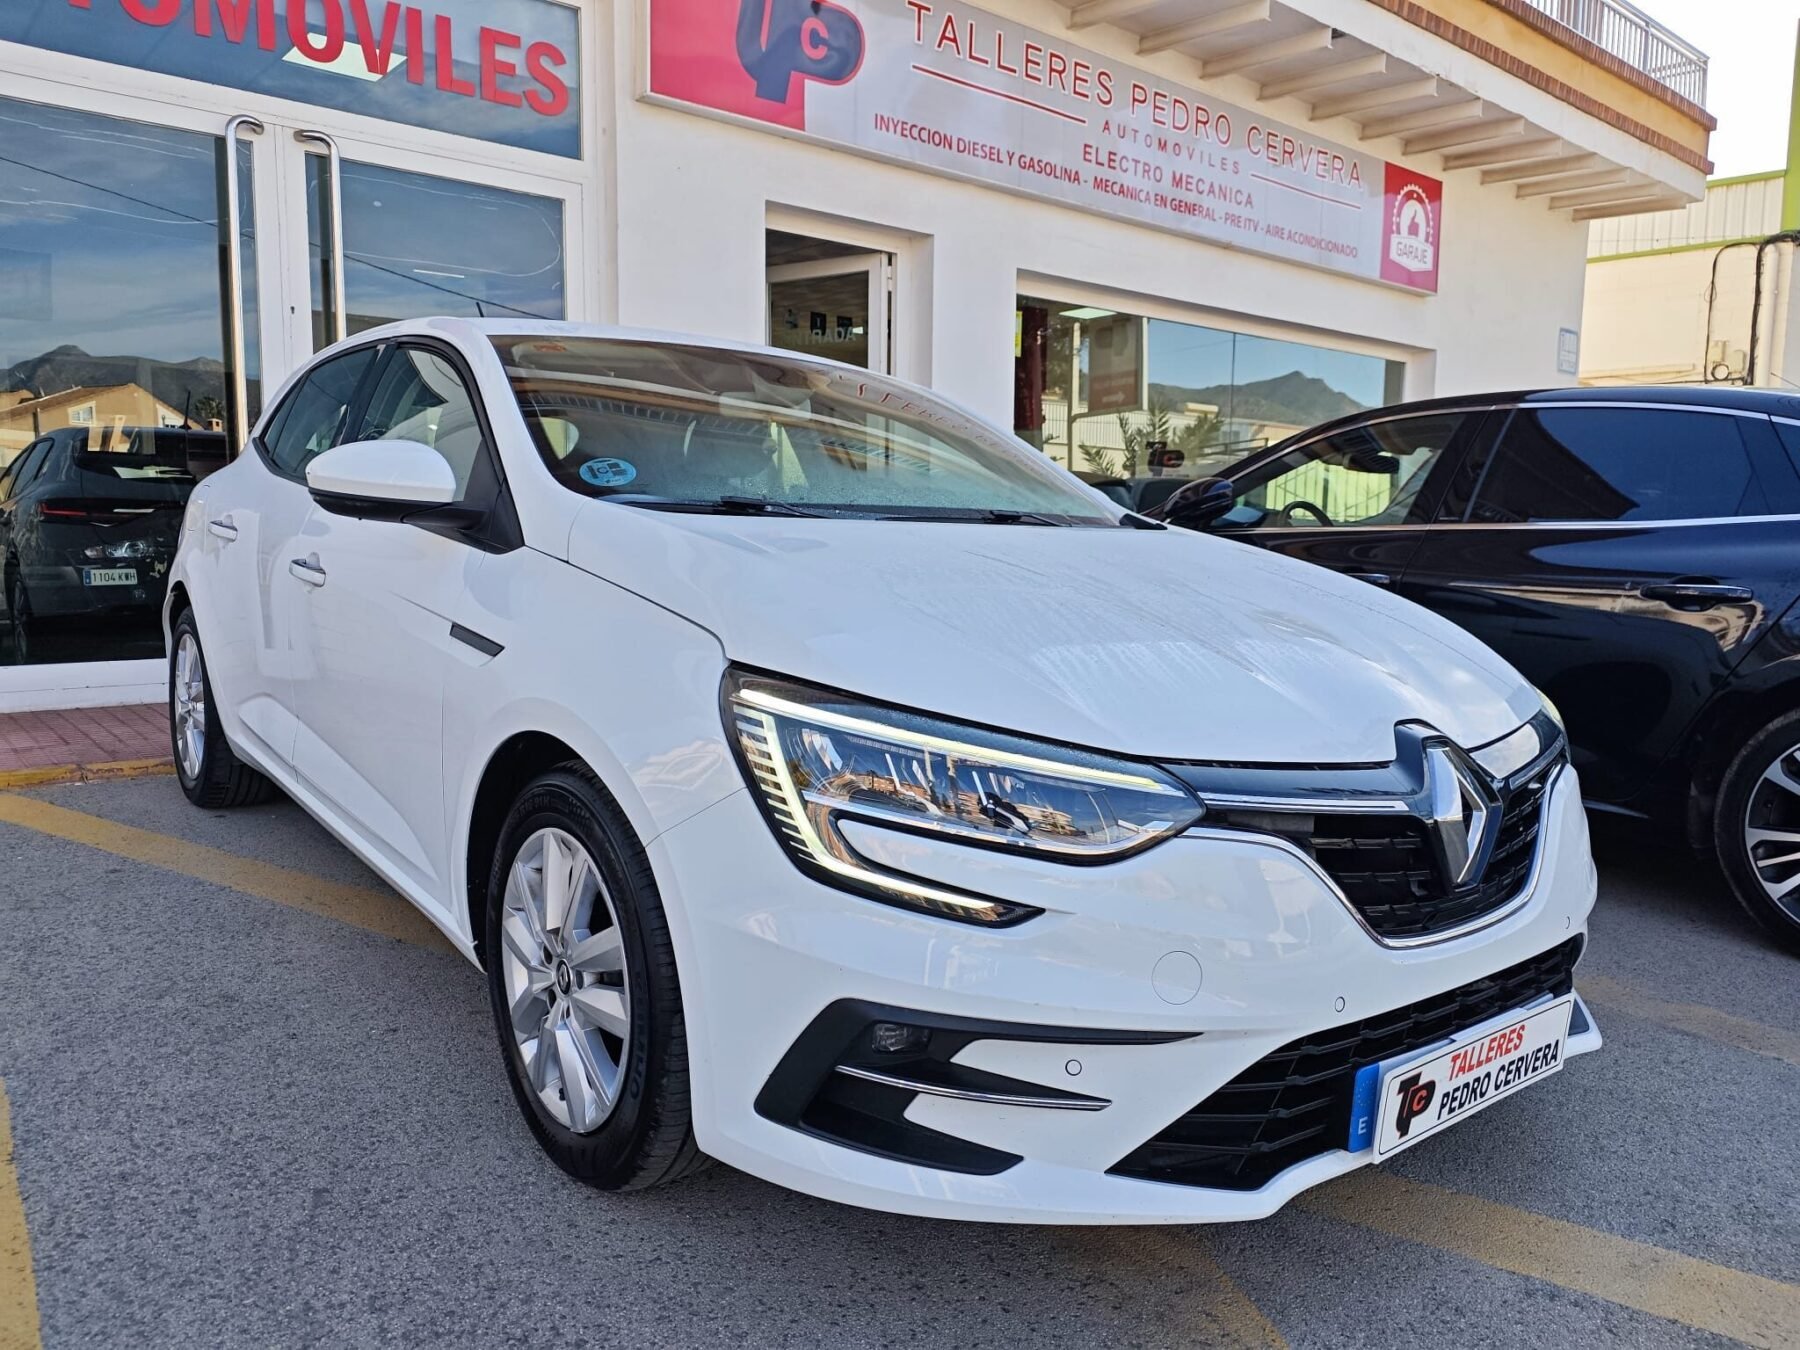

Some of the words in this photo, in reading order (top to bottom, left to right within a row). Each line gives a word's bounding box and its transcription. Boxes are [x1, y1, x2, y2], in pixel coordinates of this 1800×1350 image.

[69, 0, 571, 117] MOVILES
[906, 0, 1114, 107] TALLERES
[1131, 82, 1232, 146] PEDRO
[1246, 124, 1363, 189] CERVERA
[1082, 143, 1163, 184] ELECTRO
[1171, 170, 1255, 210] MECANICA
[1102, 119, 1241, 175] AUTOMOVILES
[874, 112, 953, 151] INYECCION
[956, 136, 1004, 165] DIESEL
[1006, 150, 1015, 167] Y
[1017, 153, 1081, 186] GASOLINA
[1092, 175, 1151, 206] MECANICA
[1153, 192, 1168, 210] EN
[1169, 197, 1217, 223] GENERAL
[1265, 223, 1286, 241] AIRE
[1286, 230, 1359, 259] ACONDICIONADO
[1396, 241, 1429, 265] GARAJE
[92, 572, 116, 583] 1104
[1436, 1070, 1492, 1121] PEDRO
[1493, 1038, 1560, 1092] CERVERA
[1448, 1023, 1526, 1082] TALLERES
[1357, 1116, 1368, 1136] E
